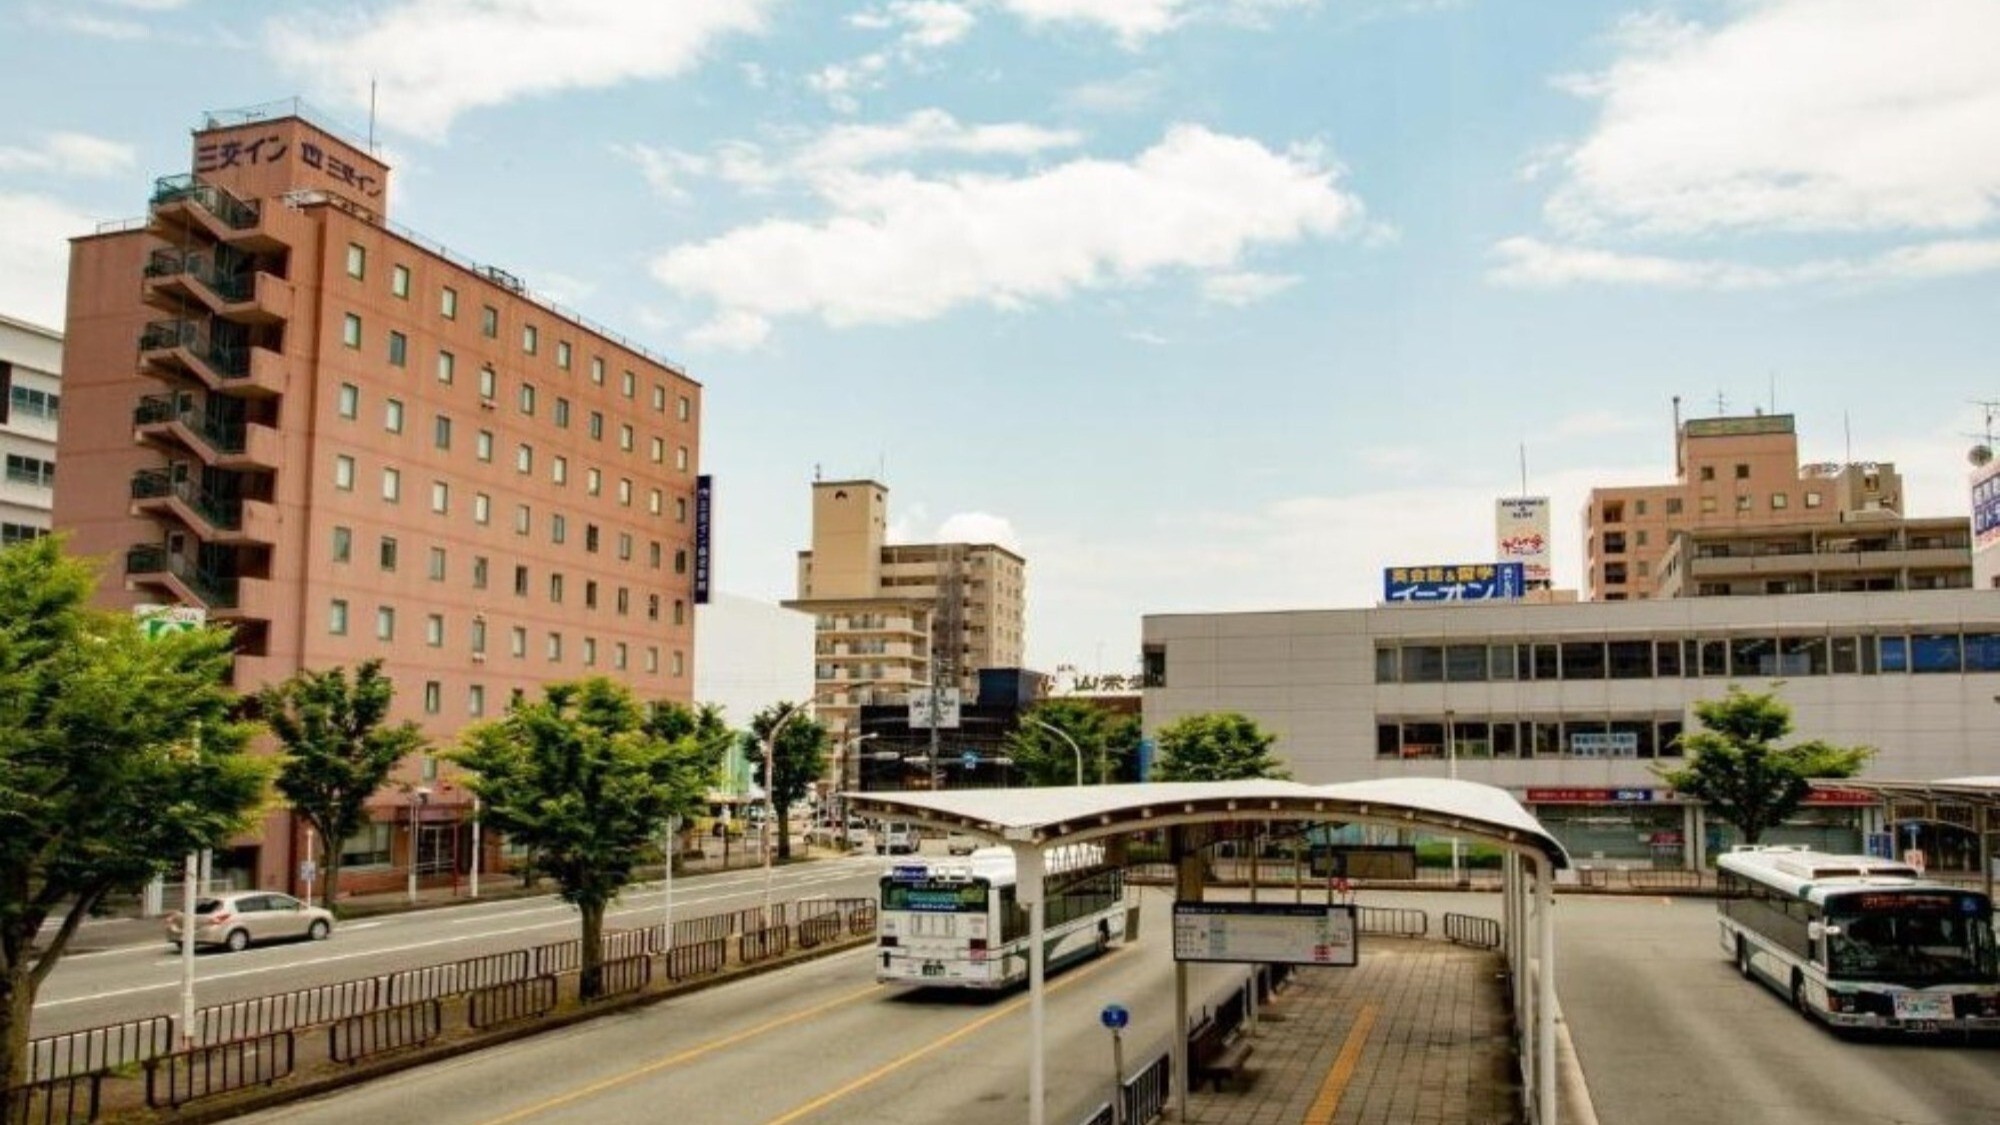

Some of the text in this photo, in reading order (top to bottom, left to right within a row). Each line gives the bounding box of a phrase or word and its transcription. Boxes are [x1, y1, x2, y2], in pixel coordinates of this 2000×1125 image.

[198, 135, 288, 173] 三交イン
[326, 154, 382, 198] 三交イン
[1391, 583, 1495, 600] イーオン
